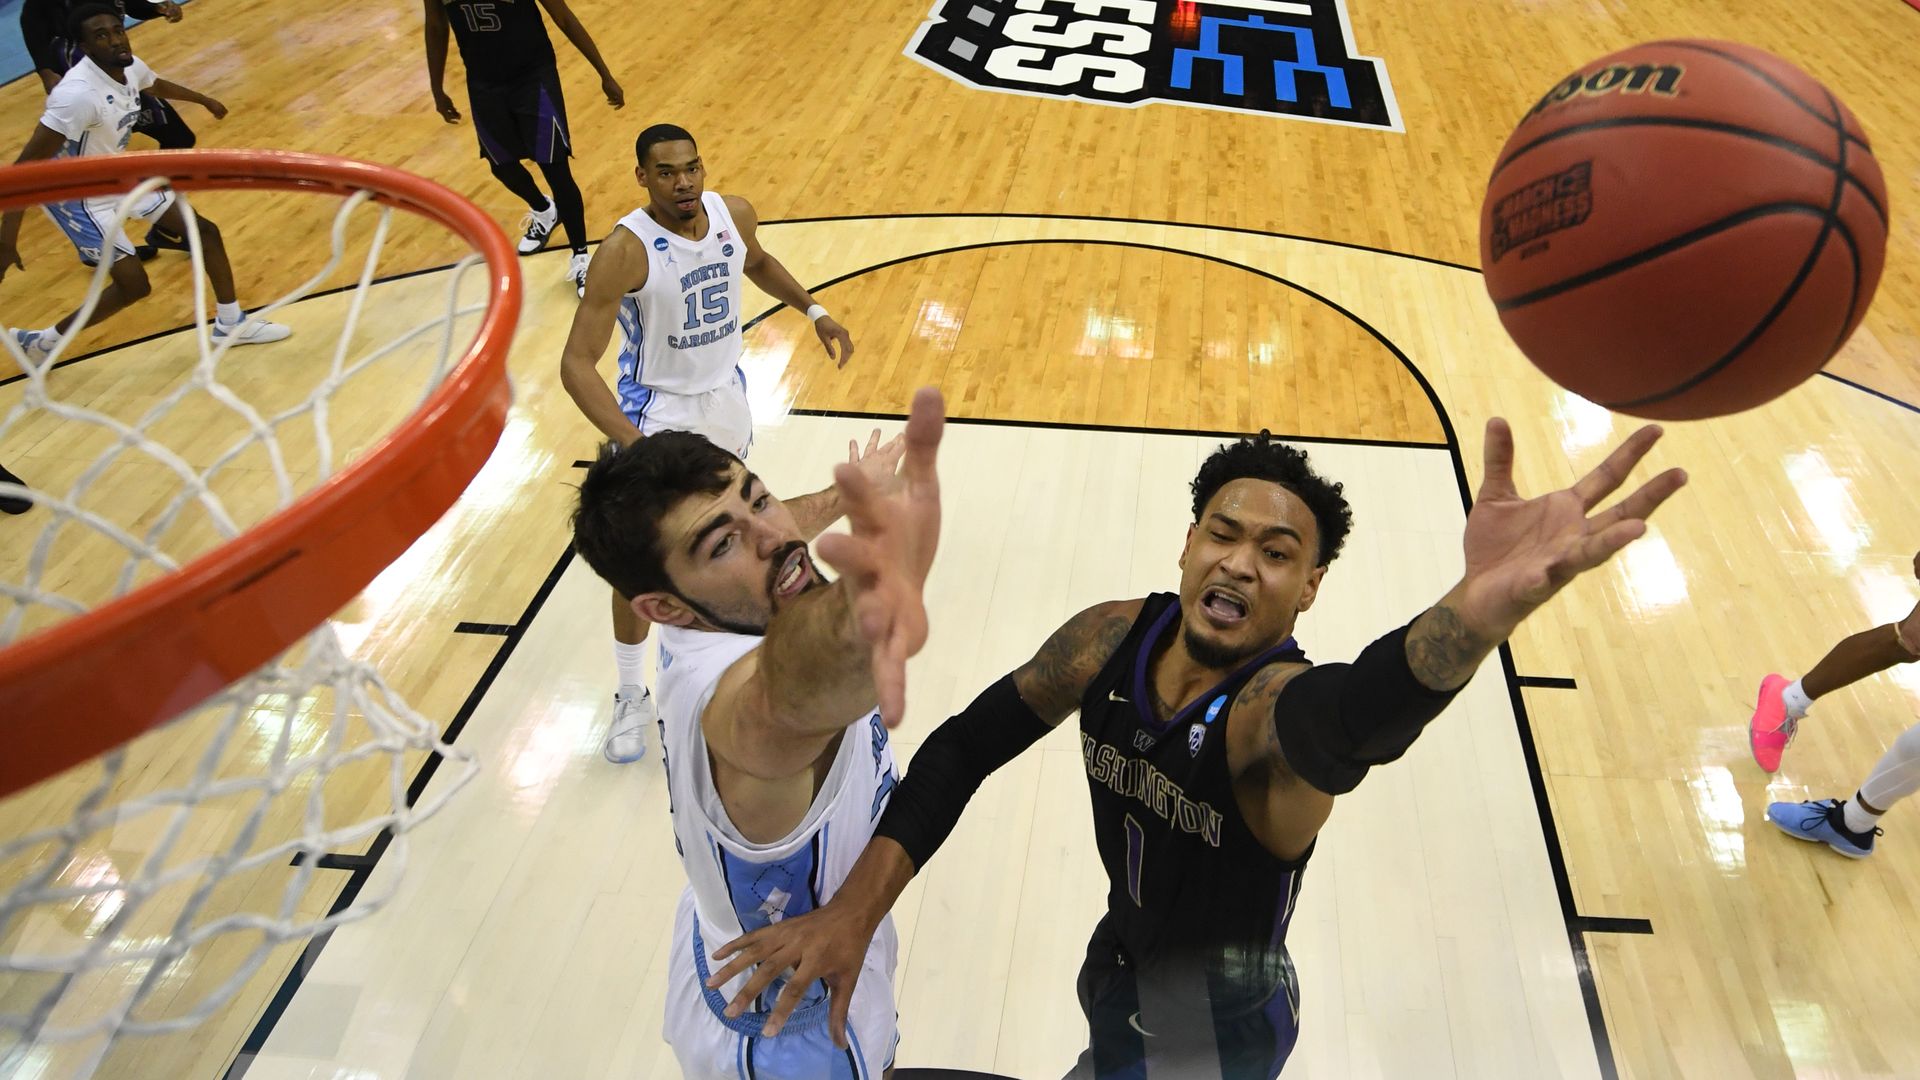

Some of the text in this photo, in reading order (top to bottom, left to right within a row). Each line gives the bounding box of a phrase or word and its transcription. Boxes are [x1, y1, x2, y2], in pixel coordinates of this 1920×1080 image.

[460, 3, 502, 32] 15
[680, 262, 729, 292] NORTH
[683, 281, 729, 330] 15
[667, 315, 738, 350] CAROLIN
[1080, 731, 1223, 848] ASHINGTON
[1123, 812, 1145, 908] 1
